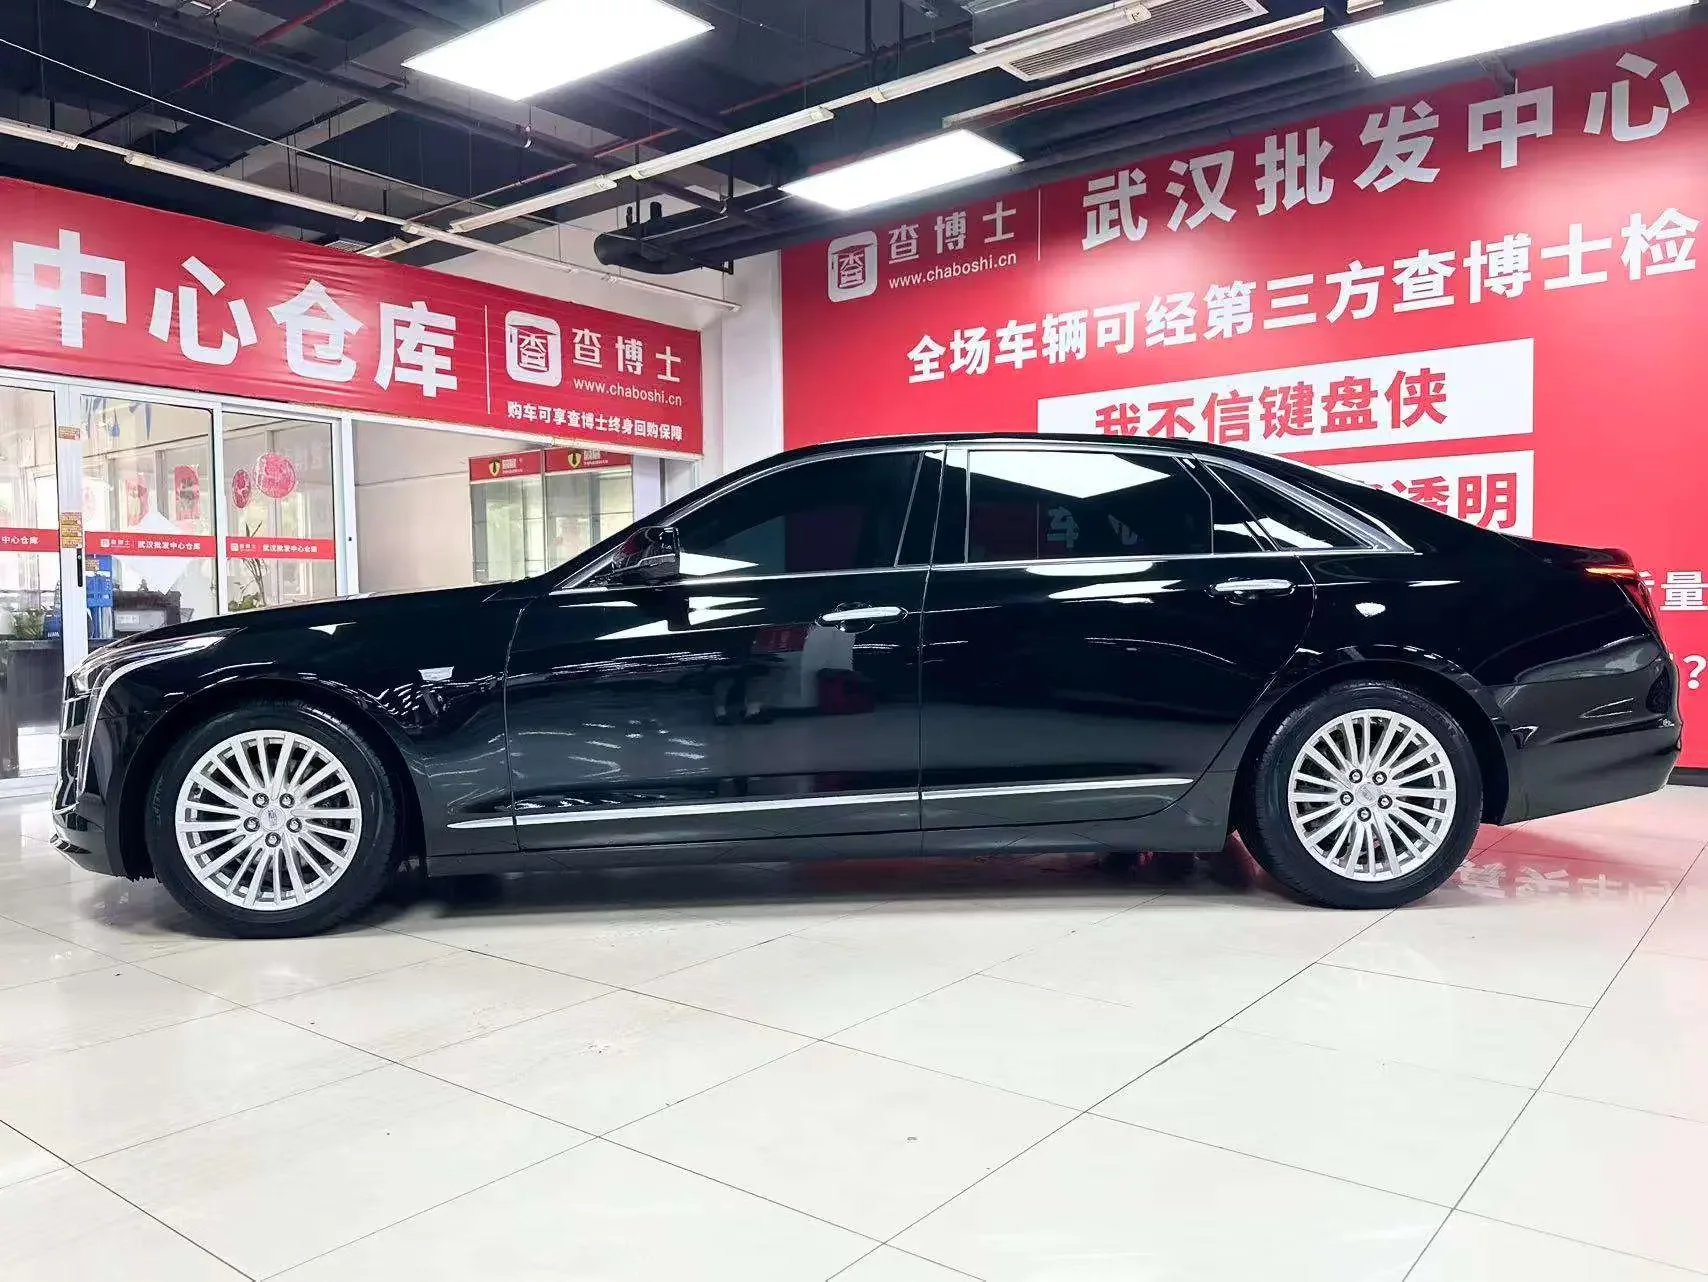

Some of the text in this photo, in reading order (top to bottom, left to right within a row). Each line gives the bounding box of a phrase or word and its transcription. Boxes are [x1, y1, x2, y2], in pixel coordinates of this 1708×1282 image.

[1081, 53, 1690, 251] 武汉批发中心
[888, 201, 1017, 264] 查博士
[889, 252, 1017, 289] www.chaboshi.cn
[907, 207, 1699, 384] 全场车辆可经第三方查博士检
[12, 229, 458, 397] 中心仓库
[572, 328, 682, 383] 查博士
[507, 401, 683, 441] 购车可享查博士终身回购保障
[573, 377, 682, 406] www.chaboshi.cn
[1096, 368, 1448, 444] 我不信键盘侠
[1370, 473, 1518, 530] 透明
